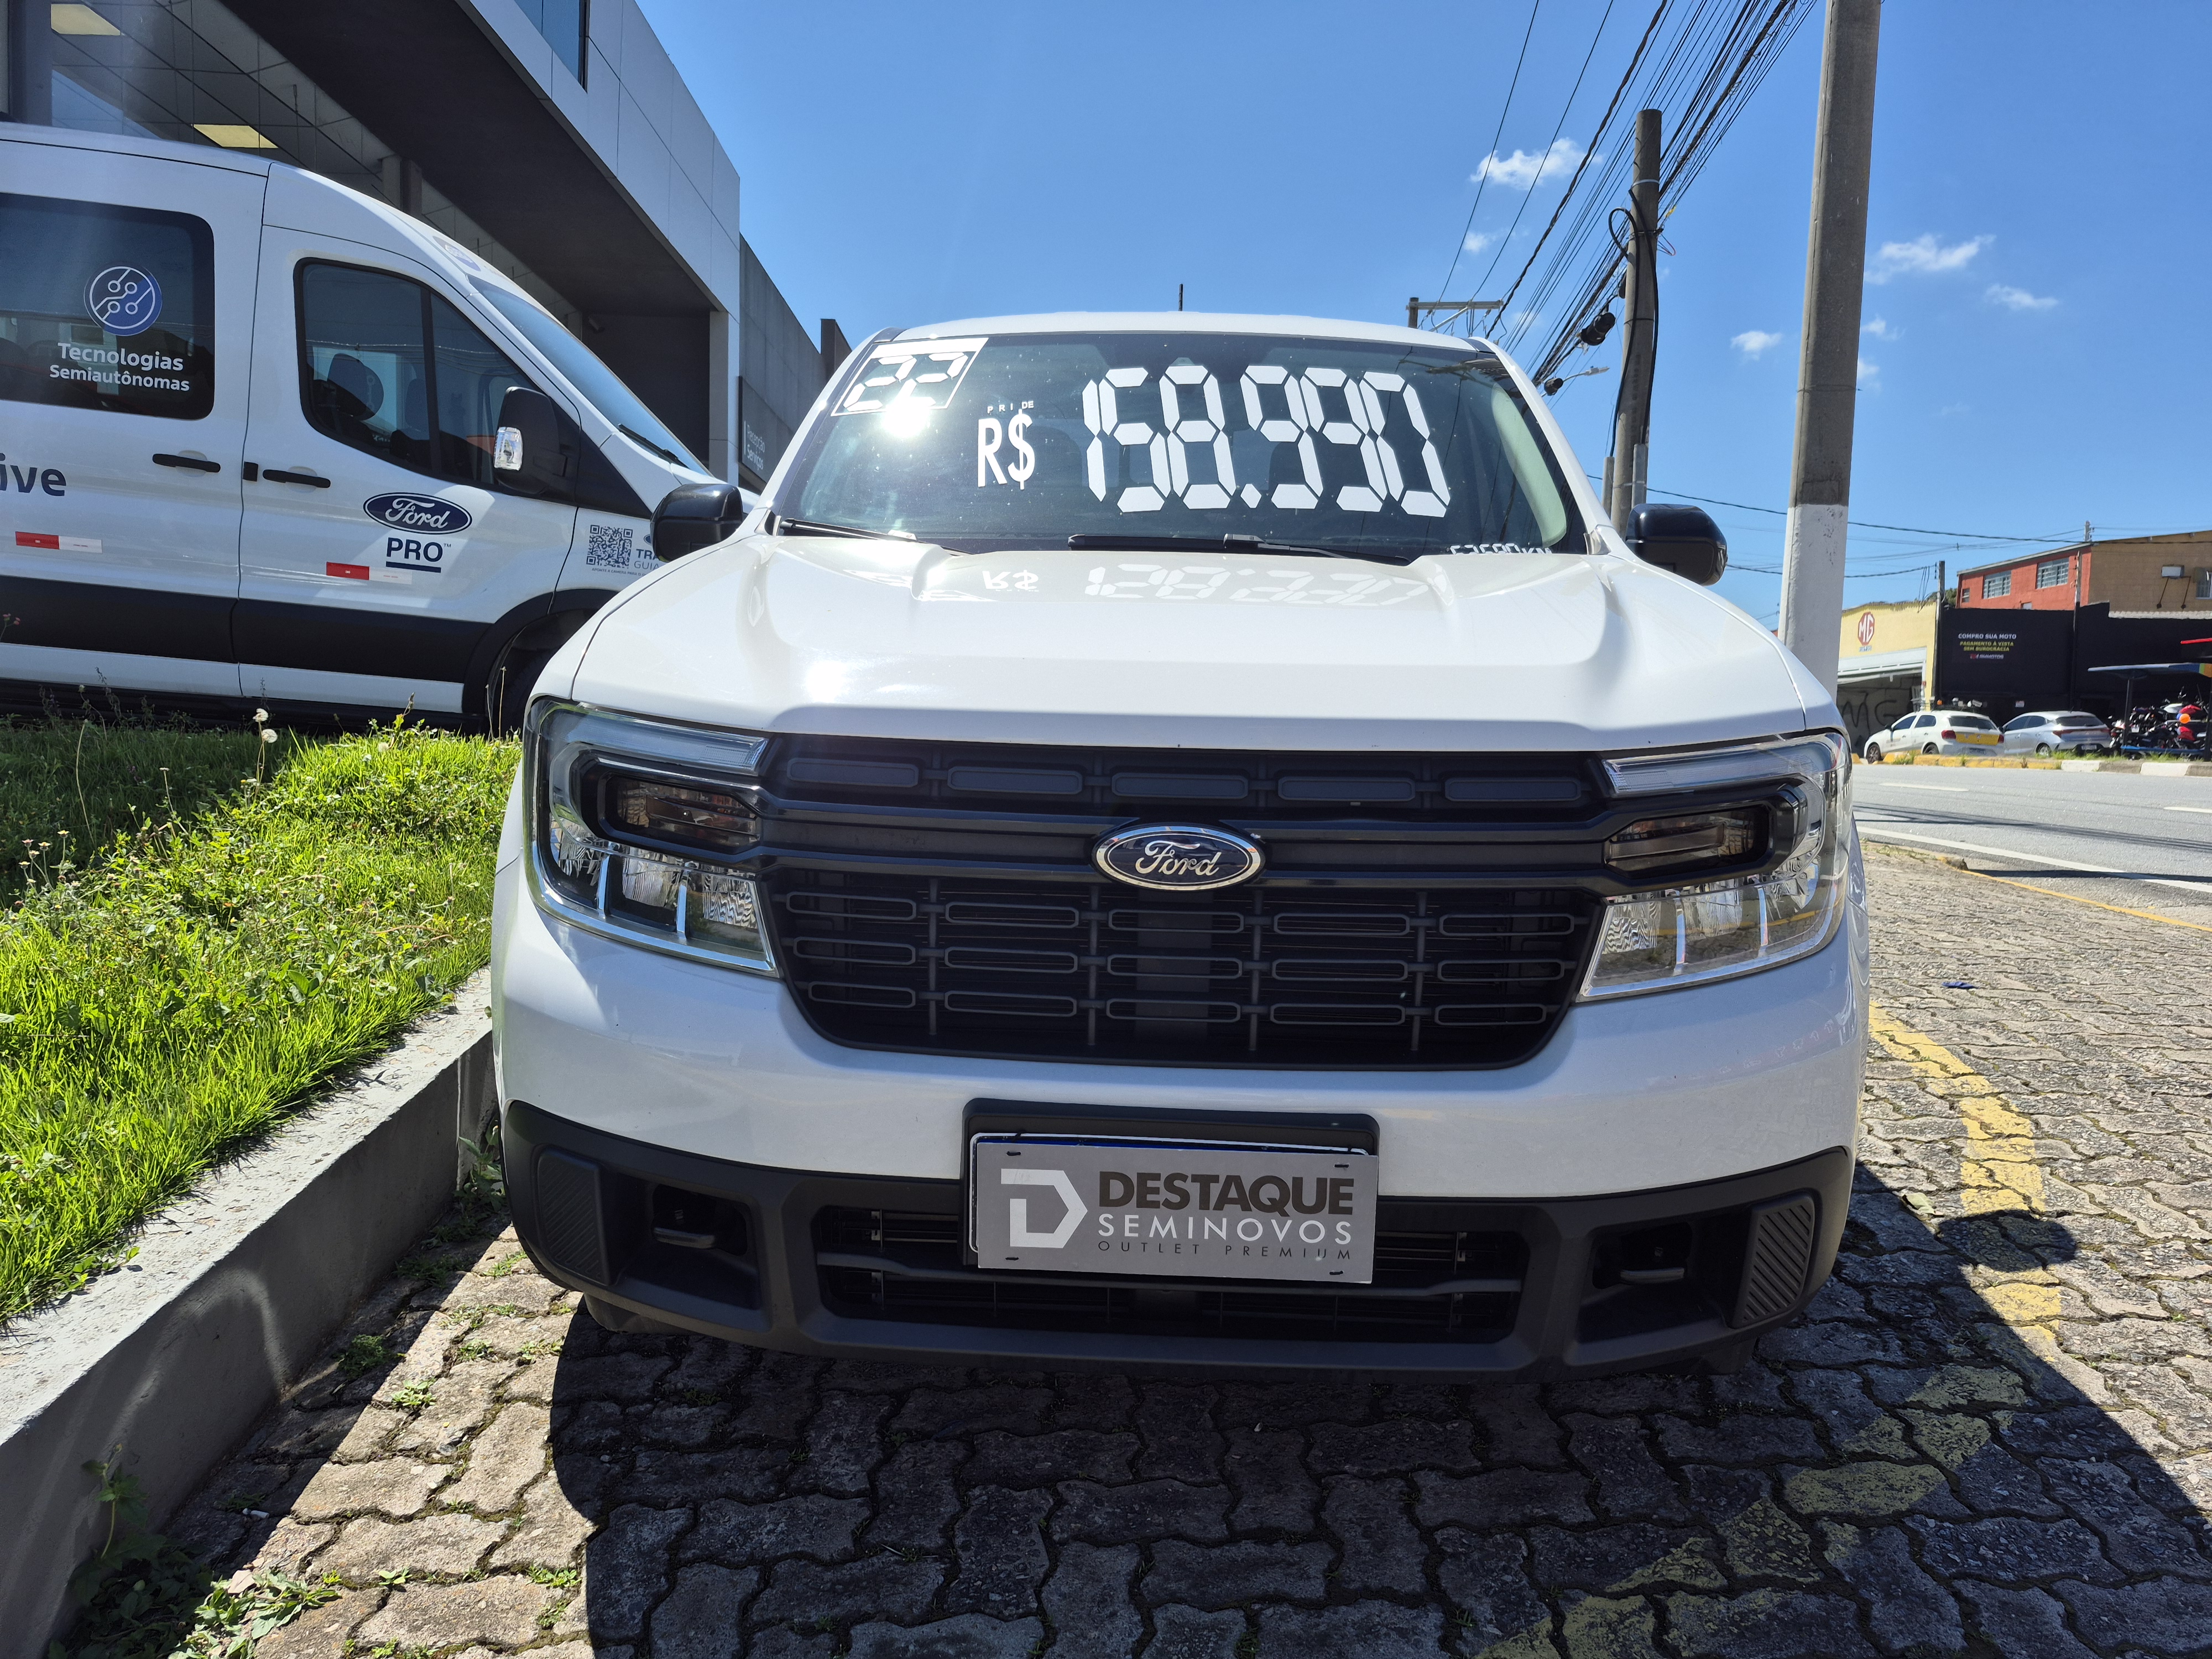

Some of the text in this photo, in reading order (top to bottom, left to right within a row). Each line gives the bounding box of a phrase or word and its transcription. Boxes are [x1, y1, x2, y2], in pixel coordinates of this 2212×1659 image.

[58, 342, 184, 371] Tecnologias
[50, 364, 190, 392] Semiautônomas
[843, 352, 968, 412] 22
[978, 365, 1451, 518] R$ 158.990
[747, 444, 764, 471] Serviços
[385, 498, 451, 529] Ford
[386, 537, 443, 562] PRO
[1859, 613, 1874, 643] MG
[1135, 840, 1222, 876] Ford
[1099, 1171, 1355, 1217] DESTAQUE
[1098, 1213, 1352, 1245] SEMINOVOS
[1098, 1241, 1350, 1260] OUTLET PREMIUM
